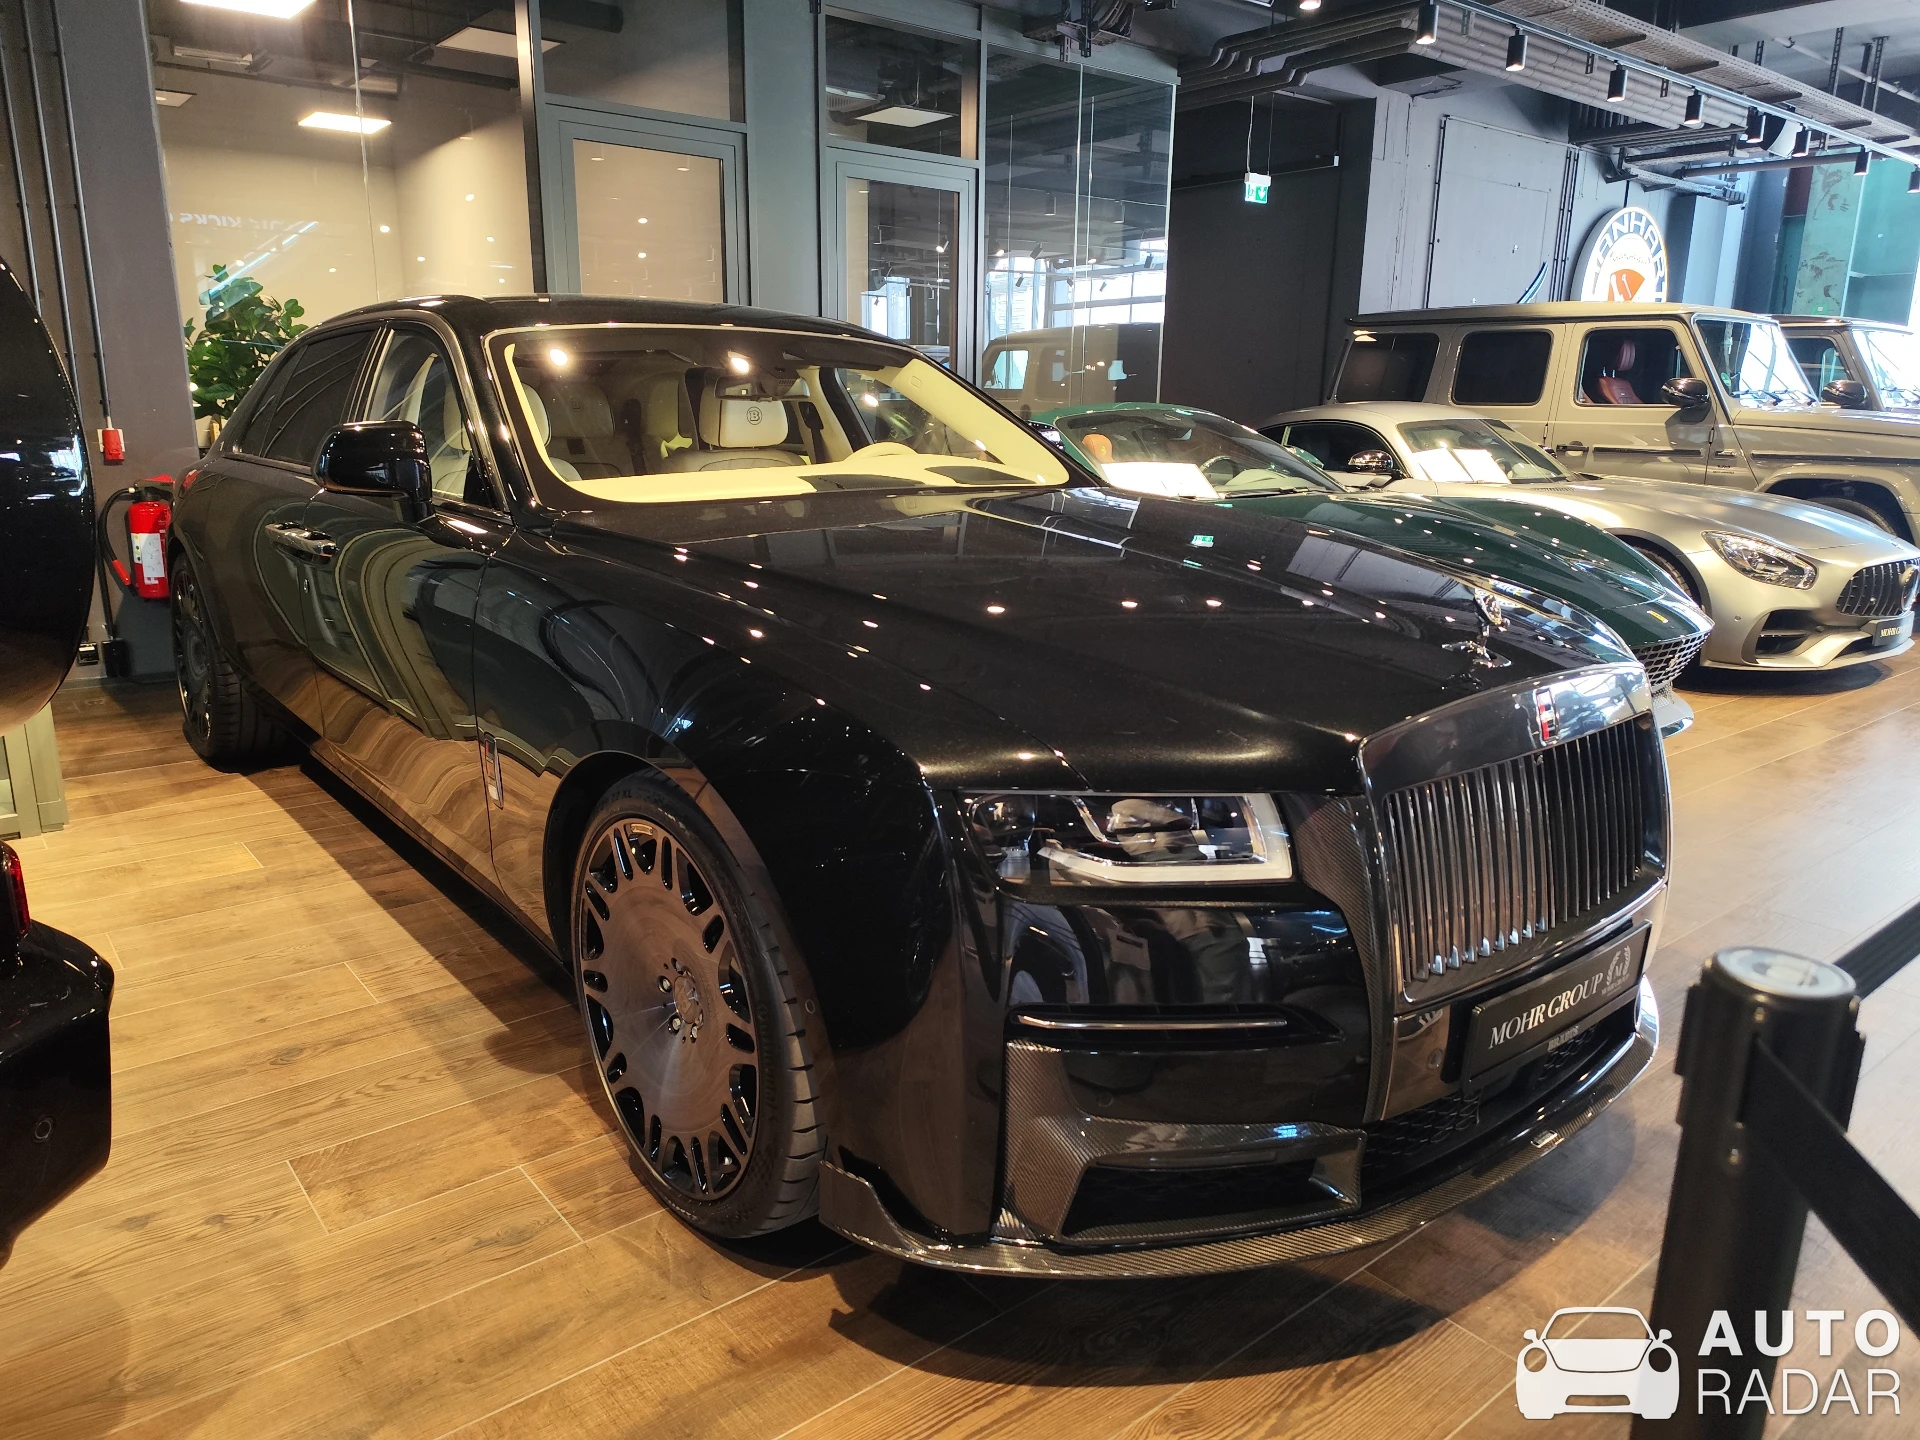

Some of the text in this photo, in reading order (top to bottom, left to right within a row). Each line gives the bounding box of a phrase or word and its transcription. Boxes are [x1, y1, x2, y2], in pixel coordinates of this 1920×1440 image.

[1592, 211, 1666, 302] ANHART
[1488, 1003, 1545, 1050] MOHR
[1548, 972, 1604, 1018] GROUP
